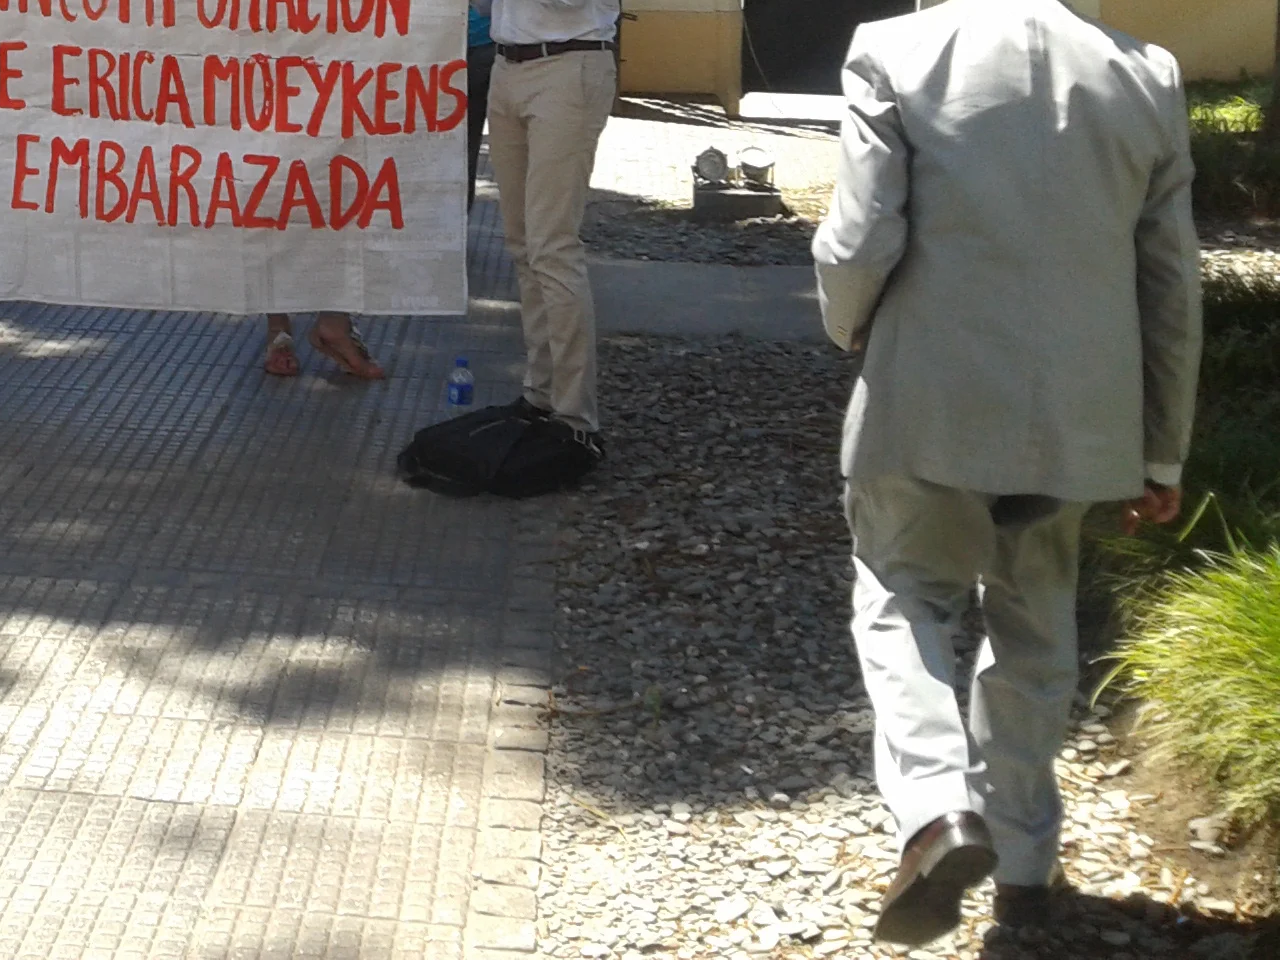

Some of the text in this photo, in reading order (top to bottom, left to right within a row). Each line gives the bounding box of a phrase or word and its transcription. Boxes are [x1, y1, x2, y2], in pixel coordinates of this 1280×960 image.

[51, 44, 195, 128] ERICA
[203, 53, 468, 138] MOEYKENS
[11, 133, 404, 230] EMBARAZADA
